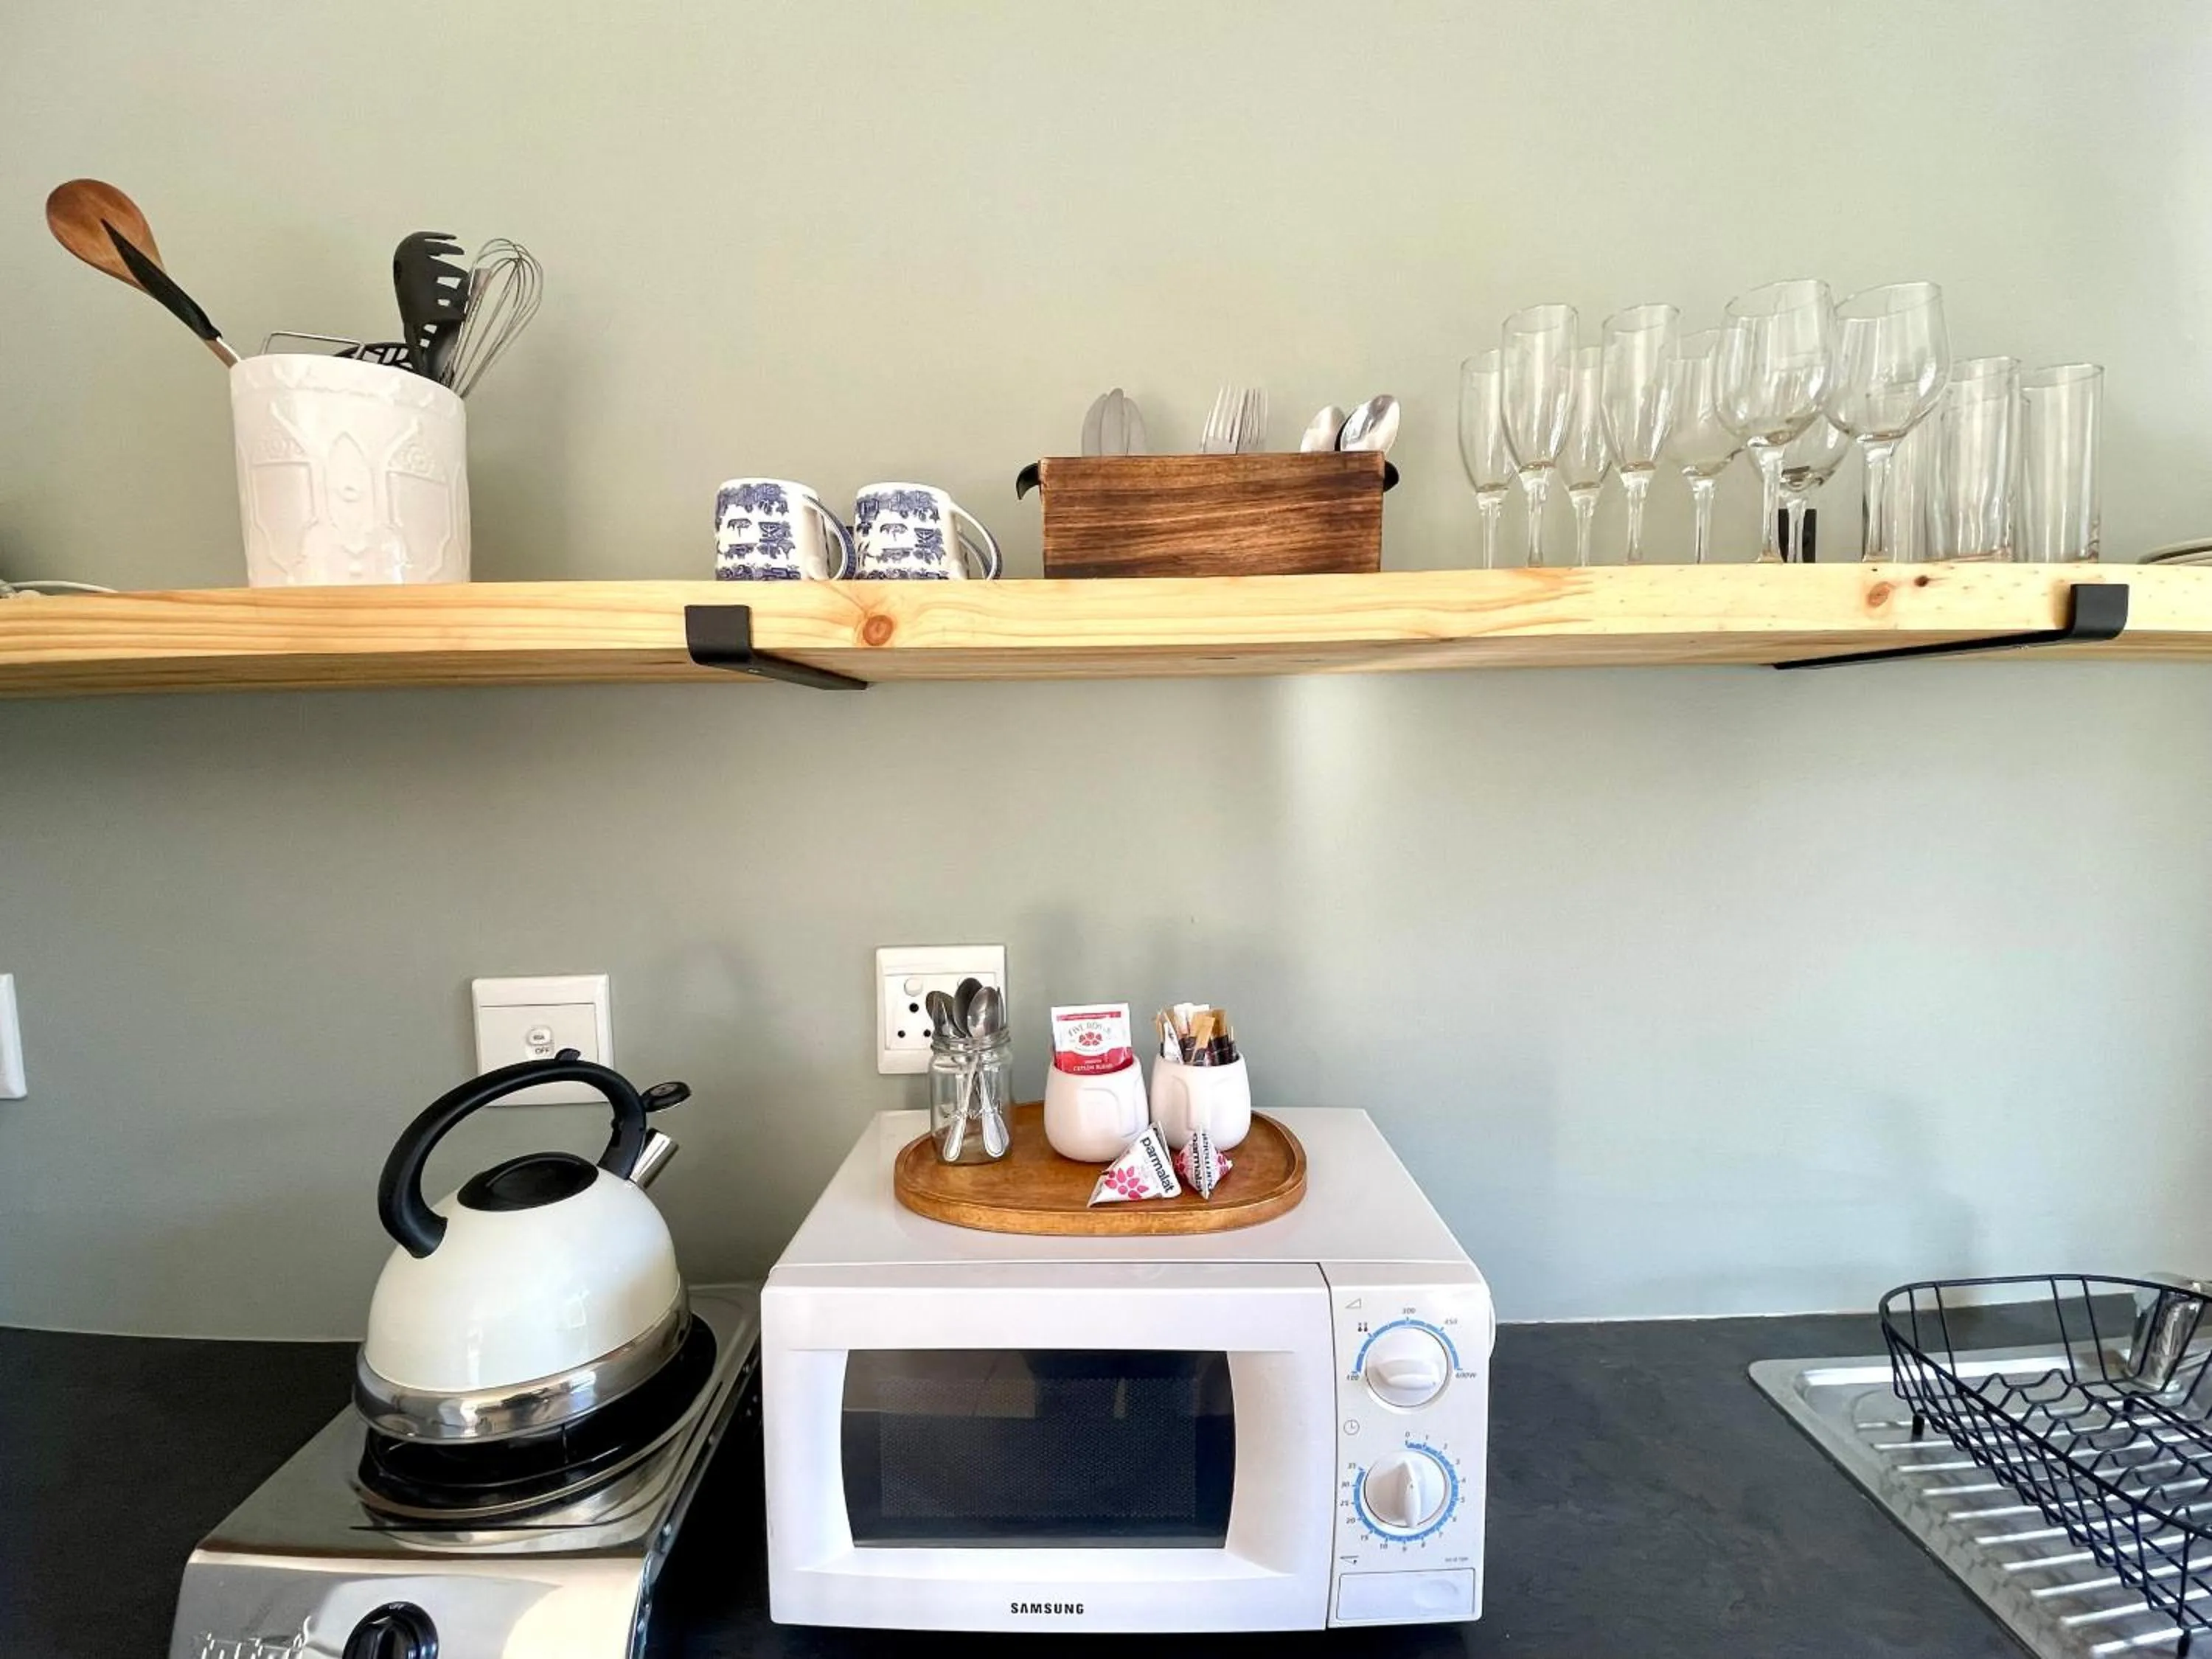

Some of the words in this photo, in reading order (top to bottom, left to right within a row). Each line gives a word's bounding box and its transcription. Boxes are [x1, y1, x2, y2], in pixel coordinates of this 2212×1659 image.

[535, 1047, 549, 1055] OFF
[1140, 1136, 1175, 1193] parmalat
[1010, 1602, 1085, 1615] SAMSUNG
